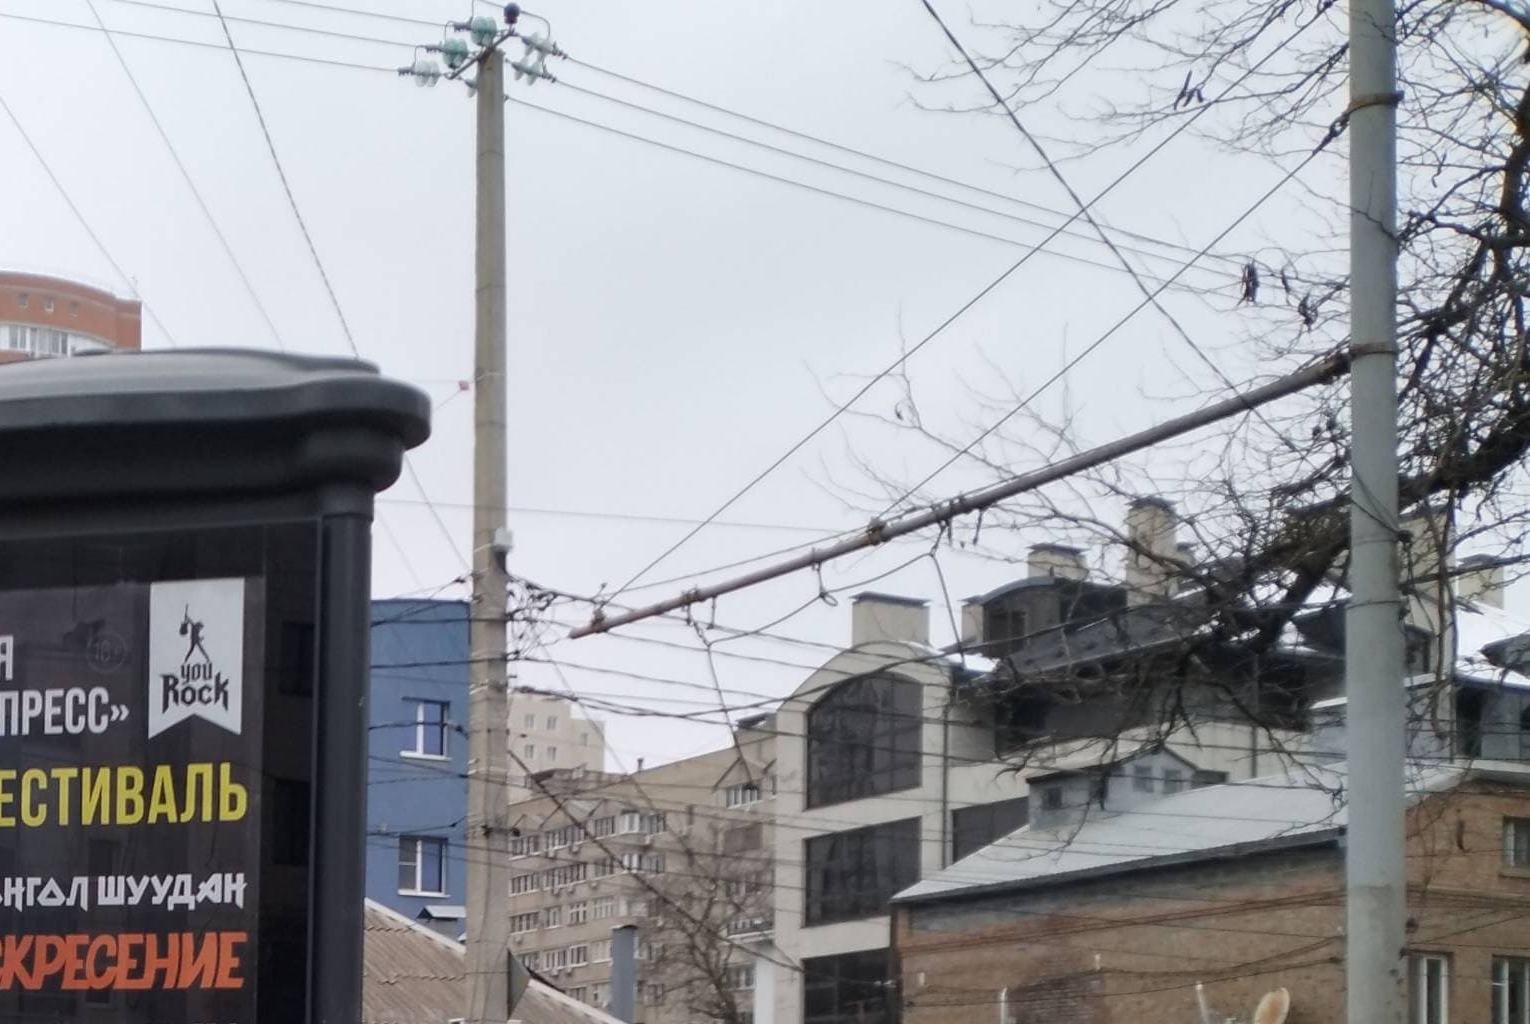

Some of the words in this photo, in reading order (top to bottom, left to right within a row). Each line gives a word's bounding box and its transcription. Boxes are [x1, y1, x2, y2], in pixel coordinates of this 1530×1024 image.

[161, 671, 229, 714] Rock
[181, 662, 213, 685] you
[97, 872, 247, 910] ШУУДАН
